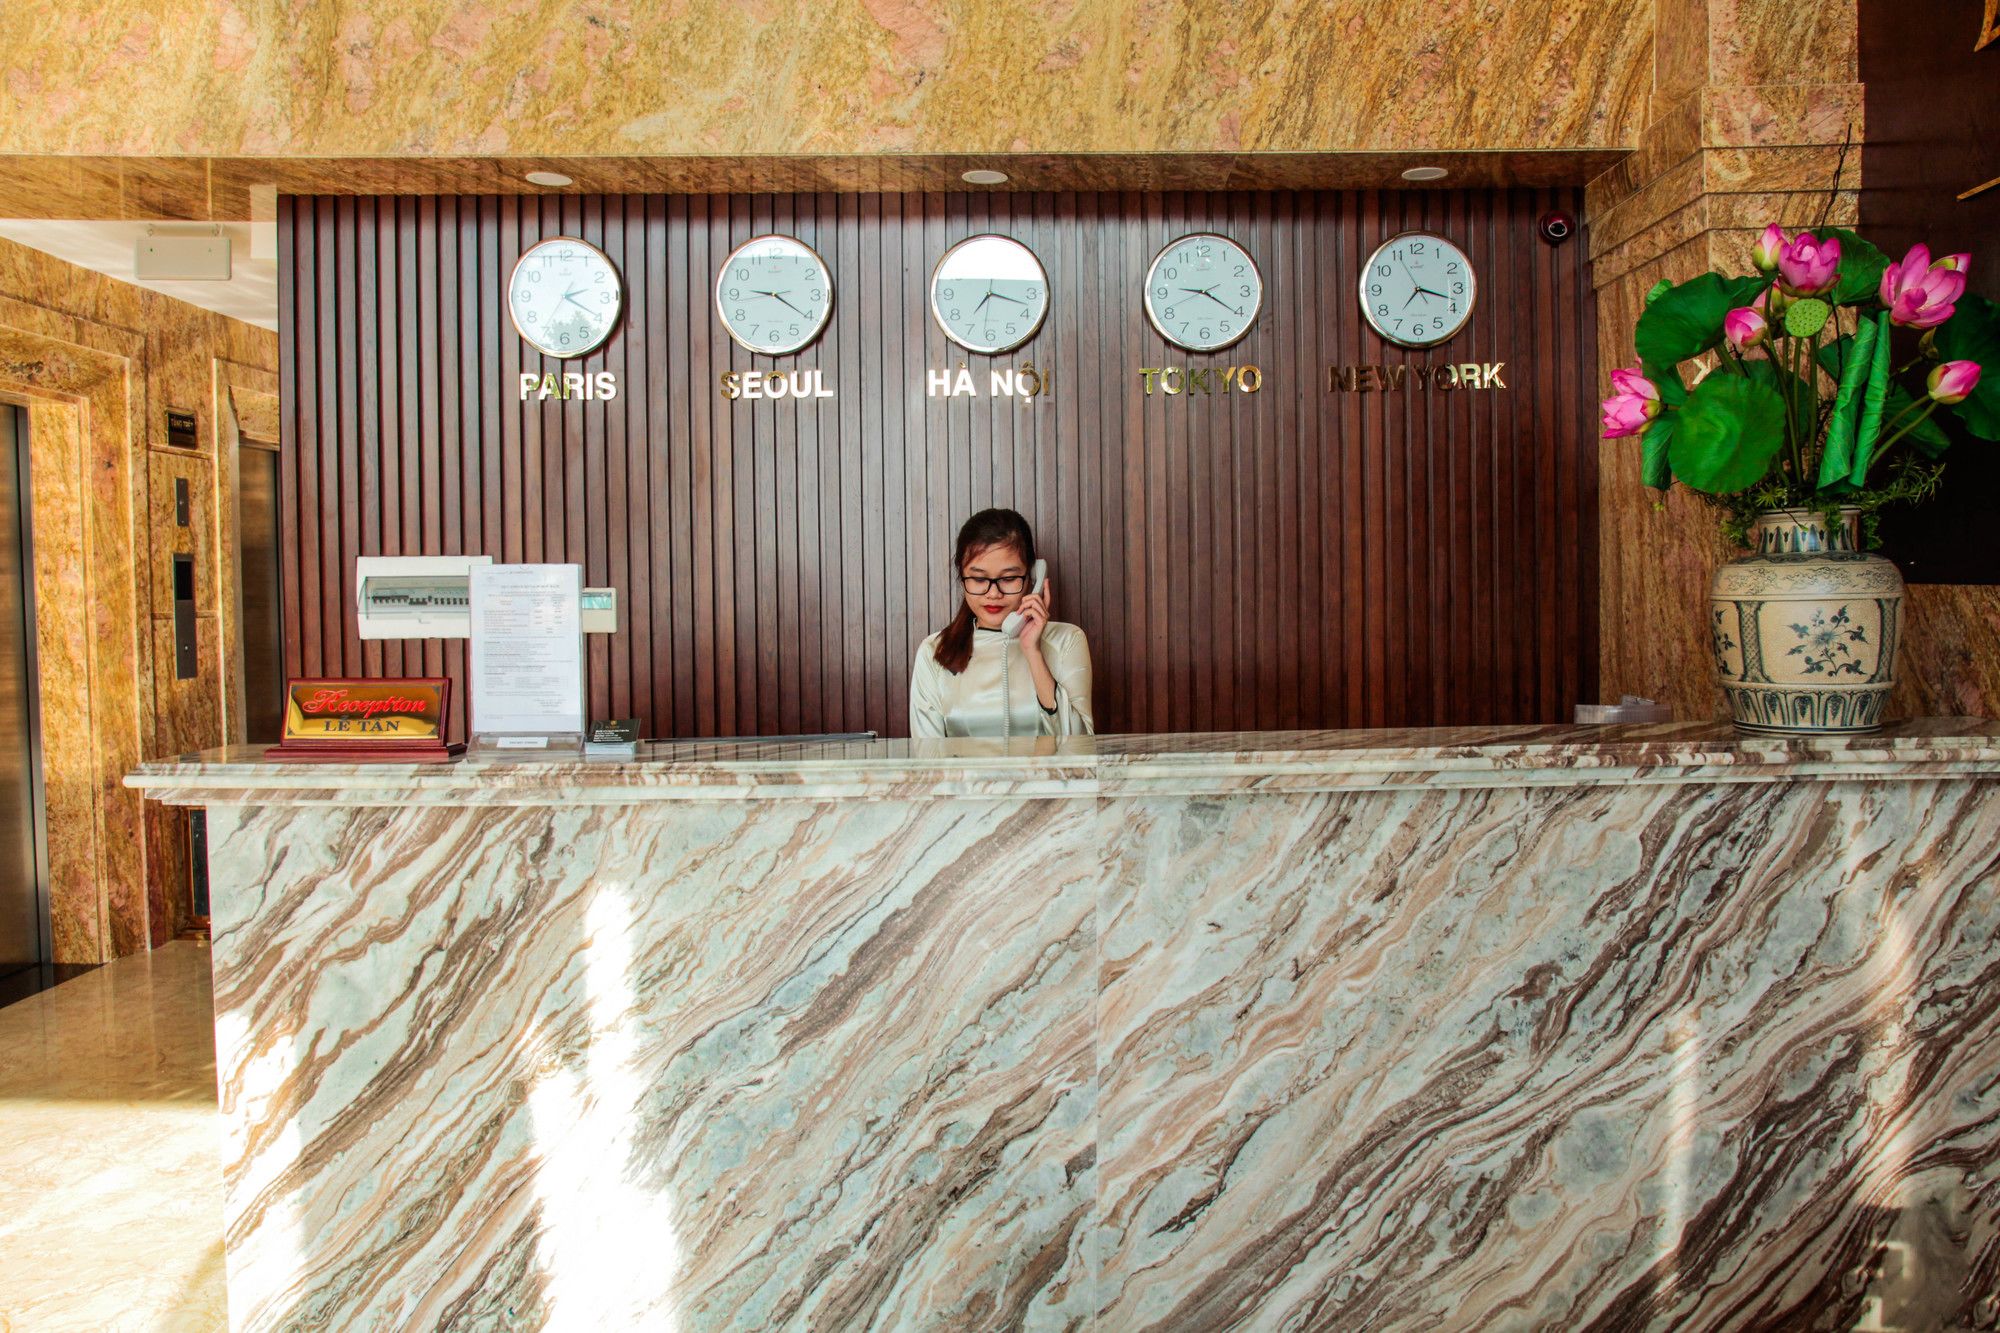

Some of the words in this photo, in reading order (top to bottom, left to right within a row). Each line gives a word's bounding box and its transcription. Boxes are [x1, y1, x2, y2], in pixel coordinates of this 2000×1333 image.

[769, 248, 783, 259] 12
[1196, 245, 1210, 257] 12
[1410, 243, 1424, 254] 12
[752, 255, 761, 264] 11
[1179, 253, 1188, 263] 11
[1393, 250, 1402, 261] 11
[543, 256, 552, 267] 11
[1164, 268, 1177, 279] 10
[1234, 266, 1244, 277] 2
[1377, 265, 1391, 276] 10
[1447, 263, 1457, 274] 2
[528, 271, 541, 283] 10
[594, 272, 605, 283] 2
[736, 269, 749, 281] 10
[805, 269, 815, 280] 2
[1027, 288, 1037, 299] 3
[1158, 288, 1168, 299] 9
[1240, 285, 1250, 297] 3
[1372, 285, 1382, 296] 9
[1453, 282, 1463, 294] 3
[521, 290, 531, 302] 9
[600, 292, 610, 303] 3
[729, 289, 739, 300] 9
[811, 289, 820, 301] 3
[944, 288, 954, 300] 9
[1020, 308, 1029, 319] 4
[1165, 308, 1174, 319] 8
[1235, 306, 1244, 317] 4
[1378, 305, 1388, 316] 8
[1447, 303, 1457, 313] 4
[527, 311, 537, 323] 8
[735, 309, 745, 321] 8
[804, 310, 814, 320] 4
[950, 309, 960, 320] 8
[1005, 323, 1015, 334] 5
[1180, 322, 1189, 333] 7
[1220, 321, 1230, 332] 5
[1394, 319, 1403, 330] 7
[1433, 317, 1443, 329] 5
[579, 327, 589, 338] 5
[750, 324, 759, 335] 7
[789, 324, 799, 336] 5
[966, 324, 975, 335] 7
[1200, 327, 1210, 339] 6
[1413, 324, 1423, 336] 6
[560, 333, 569, 344] 6
[770, 330, 779, 342] 6
[986, 330, 995, 341] 6
[928, 362, 976, 397] HÀ
[991, 361, 1050, 403] NỘI
[1138, 365, 1262, 395] TOKYO
[1328, 365, 1405, 392] NEW
[1411, 362, 1506, 391] YORK
[519, 372, 617, 400] PARIS
[720, 371, 833, 399] SEOUL
[302, 689, 427, 719] Reception
